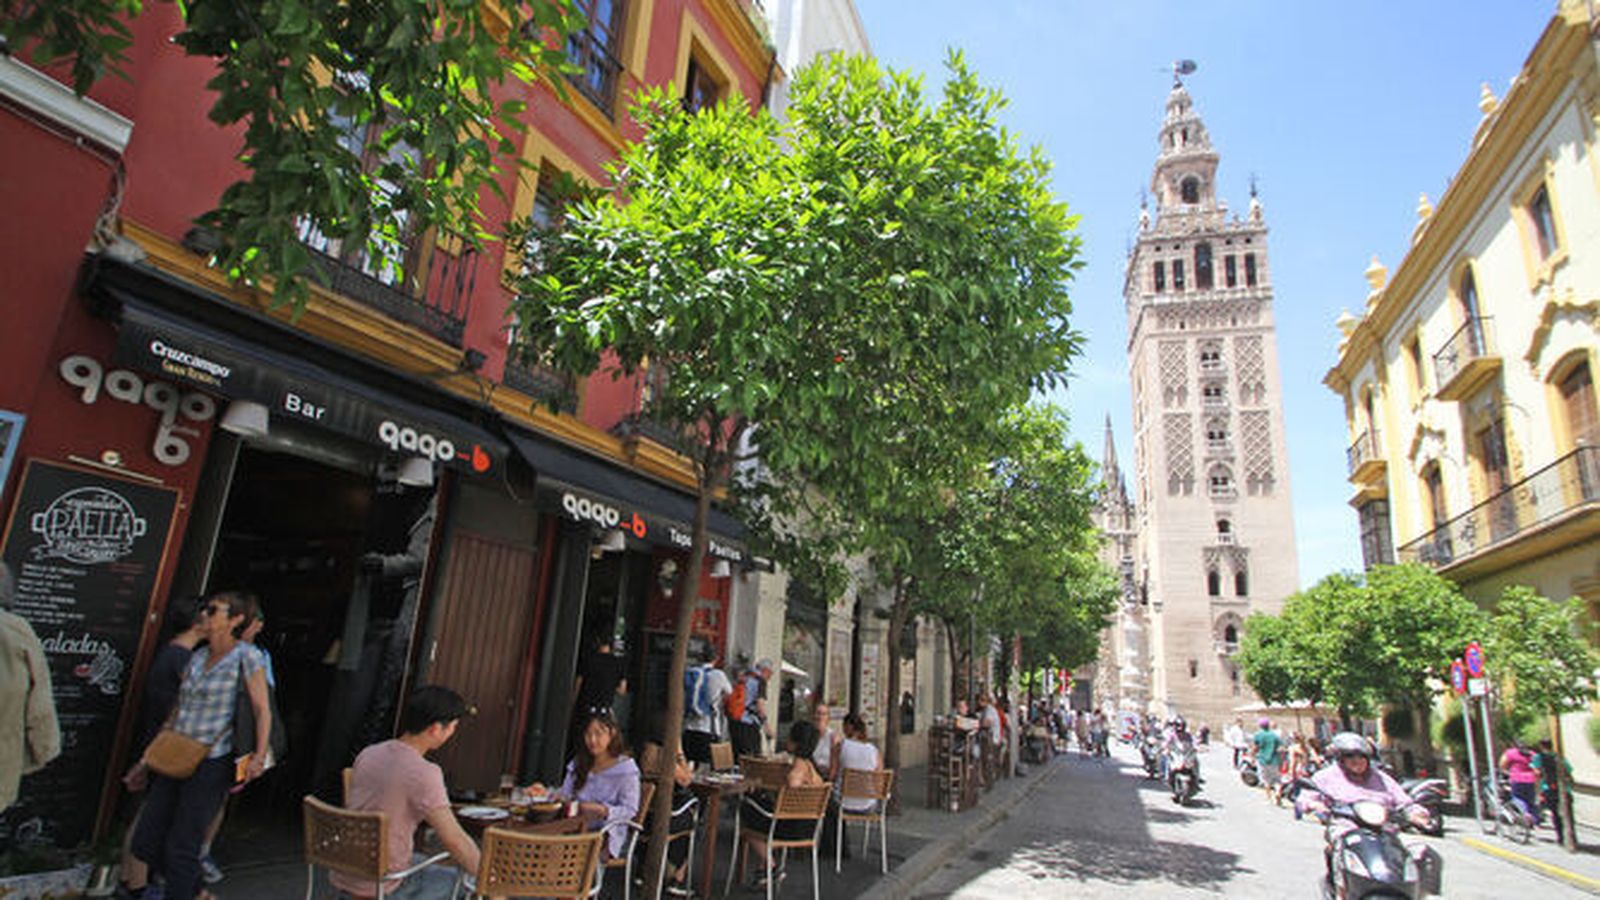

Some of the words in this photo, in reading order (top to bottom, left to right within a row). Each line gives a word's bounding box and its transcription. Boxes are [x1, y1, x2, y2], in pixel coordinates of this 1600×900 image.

[150, 341, 231, 378] Cruzcampo
[285, 393, 325, 419] Bar
[51, 508, 132, 543] PAELLA
[42, 630, 110, 655] aladas
